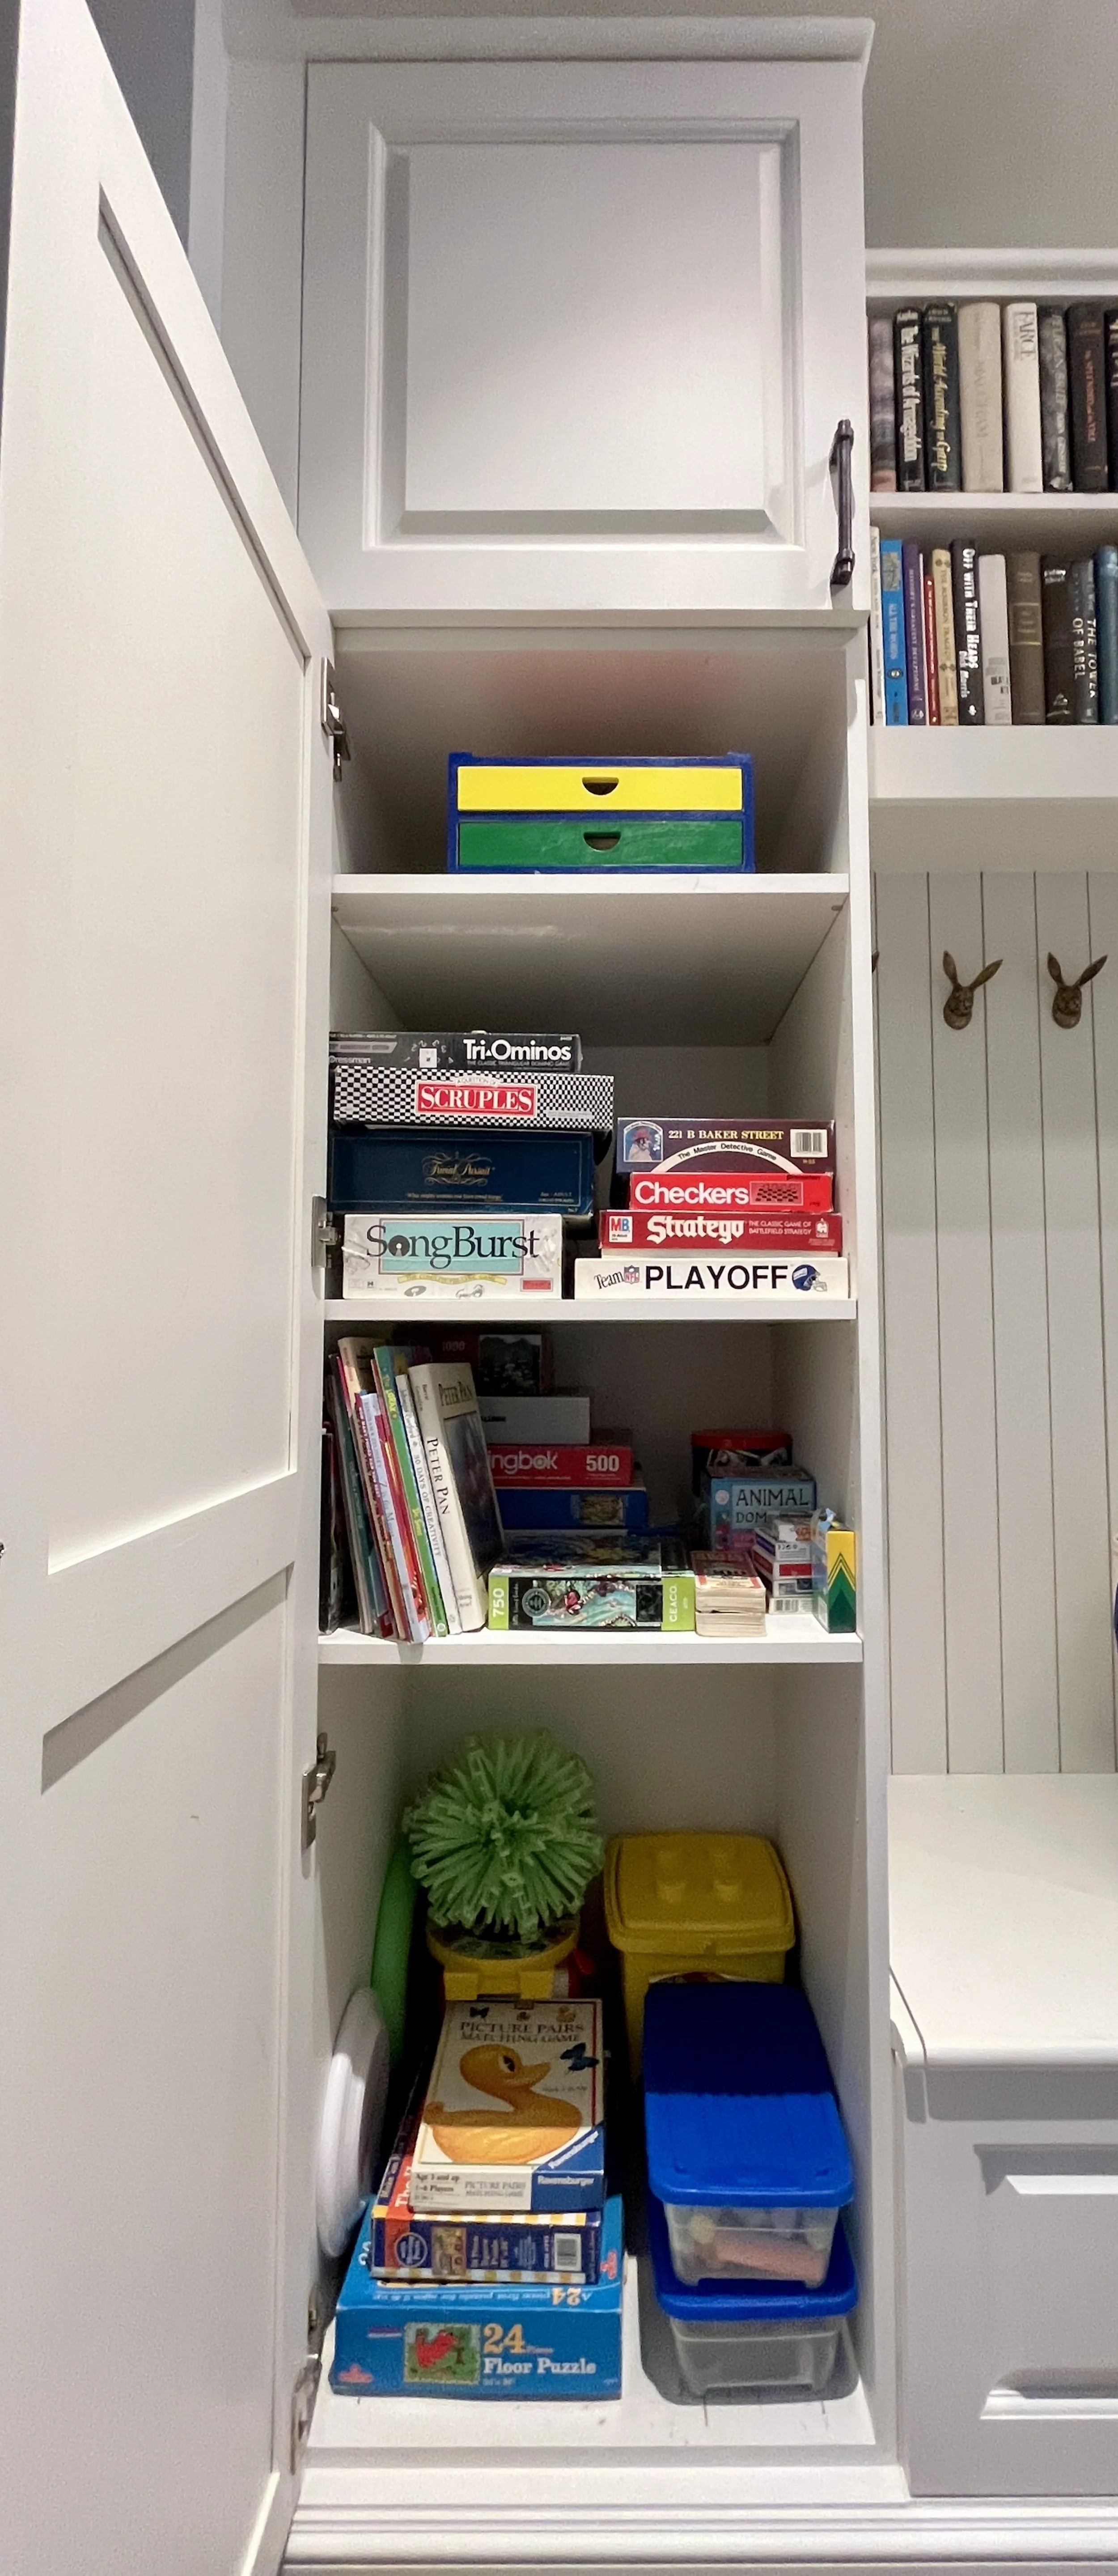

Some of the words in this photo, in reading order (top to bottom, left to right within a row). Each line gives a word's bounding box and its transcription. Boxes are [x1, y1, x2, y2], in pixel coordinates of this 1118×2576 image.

[901, 326, 919, 344] The
[1019, 311, 1037, 361] FARCE
[902, 344, 920, 385] Wizards
[902, 386, 920, 397] of
[900, 398, 922, 462] Armageddon
[931, 441, 950, 472] Garp
[962, 548, 975, 569] OFF
[965, 600, 978, 632] THEIR
[1072, 617, 1084, 638] OF
[1086, 620, 1097, 645] THE
[966, 634, 979, 669] HEADS
[1074, 640, 1085, 680] BABEL
[959, 670, 971, 698] Morris
[421, 1086, 533, 1112] SCRUPLES
[668, 1130, 682, 1139] 221
[687, 1130, 695, 1139] B
[699, 1130, 738, 1139] BAKER
[741, 1130, 784, 1140] STREET
[678, 1151, 690, 1159] The
[693, 1145, 716, 1154] Master
[720, 1143, 753, 1152] Detective
[757, 1149, 777, 1160] Game
[635, 1180, 750, 1205] Checkers
[611, 1218, 629, 1231] MB
[647, 1215, 745, 1244] Stratego
[367, 1226, 540, 1269] SongBurst
[594, 1272, 625, 1289] Team
[625, 1272, 639, 1282] NFL
[645, 1265, 788, 1290] PLAYOFF
[438, 1383, 460, 1407] PETER
[457, 1381, 474, 1402] PAN
[414, 1454, 421, 1465] 30
[586, 1455, 619, 1472] 500
[416, 1466, 426, 1488] DAYS
[427, 1438, 444, 1484] PETER
[436, 1486, 451, 1515] PAN
[421, 1490, 429, 1501] OF
[736, 1489, 809, 1506] ANIMAL
[424, 1504, 442, 1557] CREATIVITY
[493, 1587, 504, 1618] 750
[669, 1585, 678, 1622] CEACO
[461, 2021, 532, 2033] PICTURE
[538, 2023, 584, 2033] PAIRS
[461, 2031, 538, 2043] MATCHING
[541, 2033, 580, 2043] GAME
[551, 2287, 582, 2305] 24
[483, 2323, 525, 2354] 24
[483, 2357, 533, 2374] Floor
[537, 2357, 597, 2374] Puzzle
